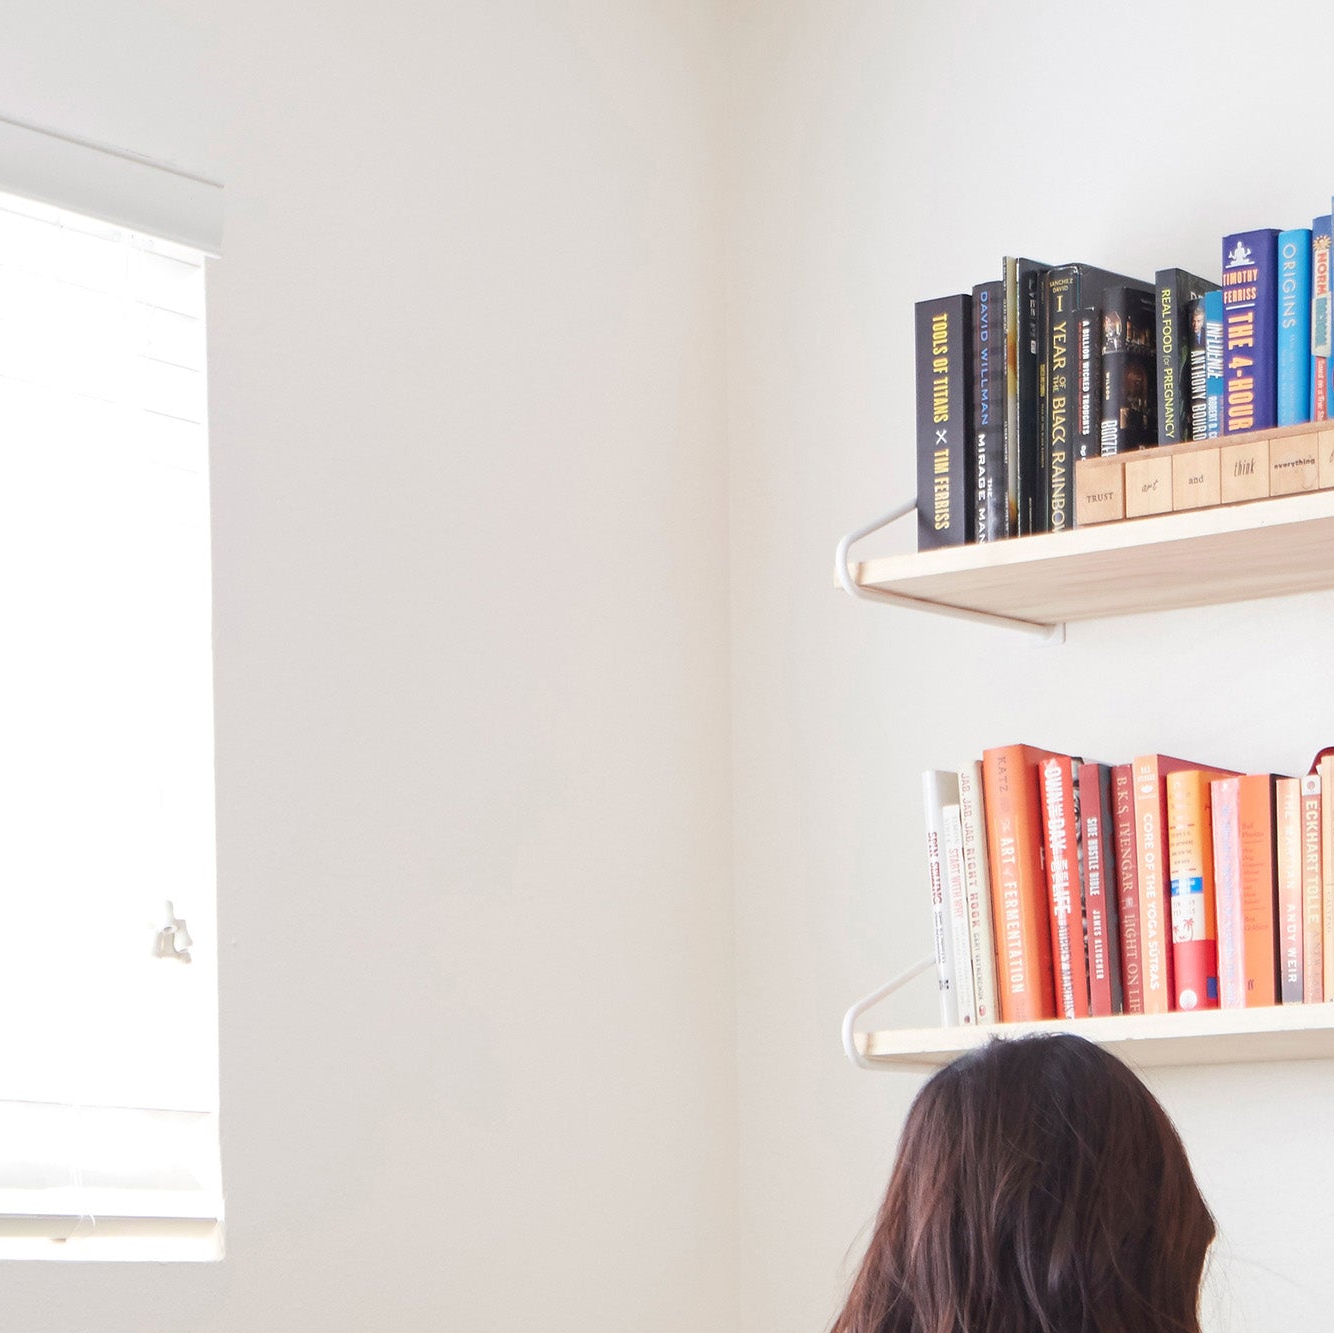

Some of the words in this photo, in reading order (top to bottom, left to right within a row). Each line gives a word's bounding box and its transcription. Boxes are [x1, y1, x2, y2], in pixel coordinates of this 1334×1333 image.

[1224, 269, 1258, 287] TIMOTHY
[1224, 287, 1256, 304] FERRISS
[1282, 243, 1297, 329] ORIGINS
[980, 291, 988, 341] DAVID
[1161, 289, 1171, 315] REAL
[932, 313, 949, 355] TOOLS
[1053, 322, 1066, 371] YEAR
[1162, 319, 1172, 353] FOOD
[1228, 312, 1254, 349] THE
[933, 358, 949, 373] OF
[1059, 376, 1066, 389] OF
[933, 376, 949, 424] TITANS
[980, 348, 988, 425] WILLMAN
[1164, 368, 1175, 439] PREGNANCY
[1228, 355, 1254, 431] 4-HOUR
[1052, 397, 1066, 445] BLACK
[934, 448, 949, 475] TIM
[977, 433, 985, 501] MIRAGE
[1086, 491, 1115, 504] TRUST
[1188, 474, 1204, 486] and
[1233, 456, 1256, 479] think
[1274, 456, 1316, 471] everything
[934, 478, 949, 530] FERRISS
[997, 756, 1008, 794] KATZ
[1087, 817, 1098, 838] SIDE
[1143, 813, 1154, 850] CORE
[1305, 800, 1318, 869] ECKHART
[948, 848, 960, 875] START
[966, 847, 978, 887] RIGHT
[1000, 837, 1015, 864] ART
[1088, 839, 1100, 871] HUSTLE
[1145, 852, 1155, 866] OF
[950, 875, 962, 897] WITH
[1089, 873, 1100, 896] BIBLE
[1145, 867, 1156, 899] THE
[1307, 872, 1319, 924] TOLLE
[952, 897, 964, 919] WHY
[970, 893, 981, 928] HOOK
[1093, 910, 1101, 937] JAMES
[1146, 900, 1158, 938] YOGA
[1286, 904, 1296, 943] ANDY
[1004, 882, 1024, 995] FERMENTATION
[1094, 939, 1104, 980] ALTUCHER
[1288, 947, 1298, 983] WEIR
